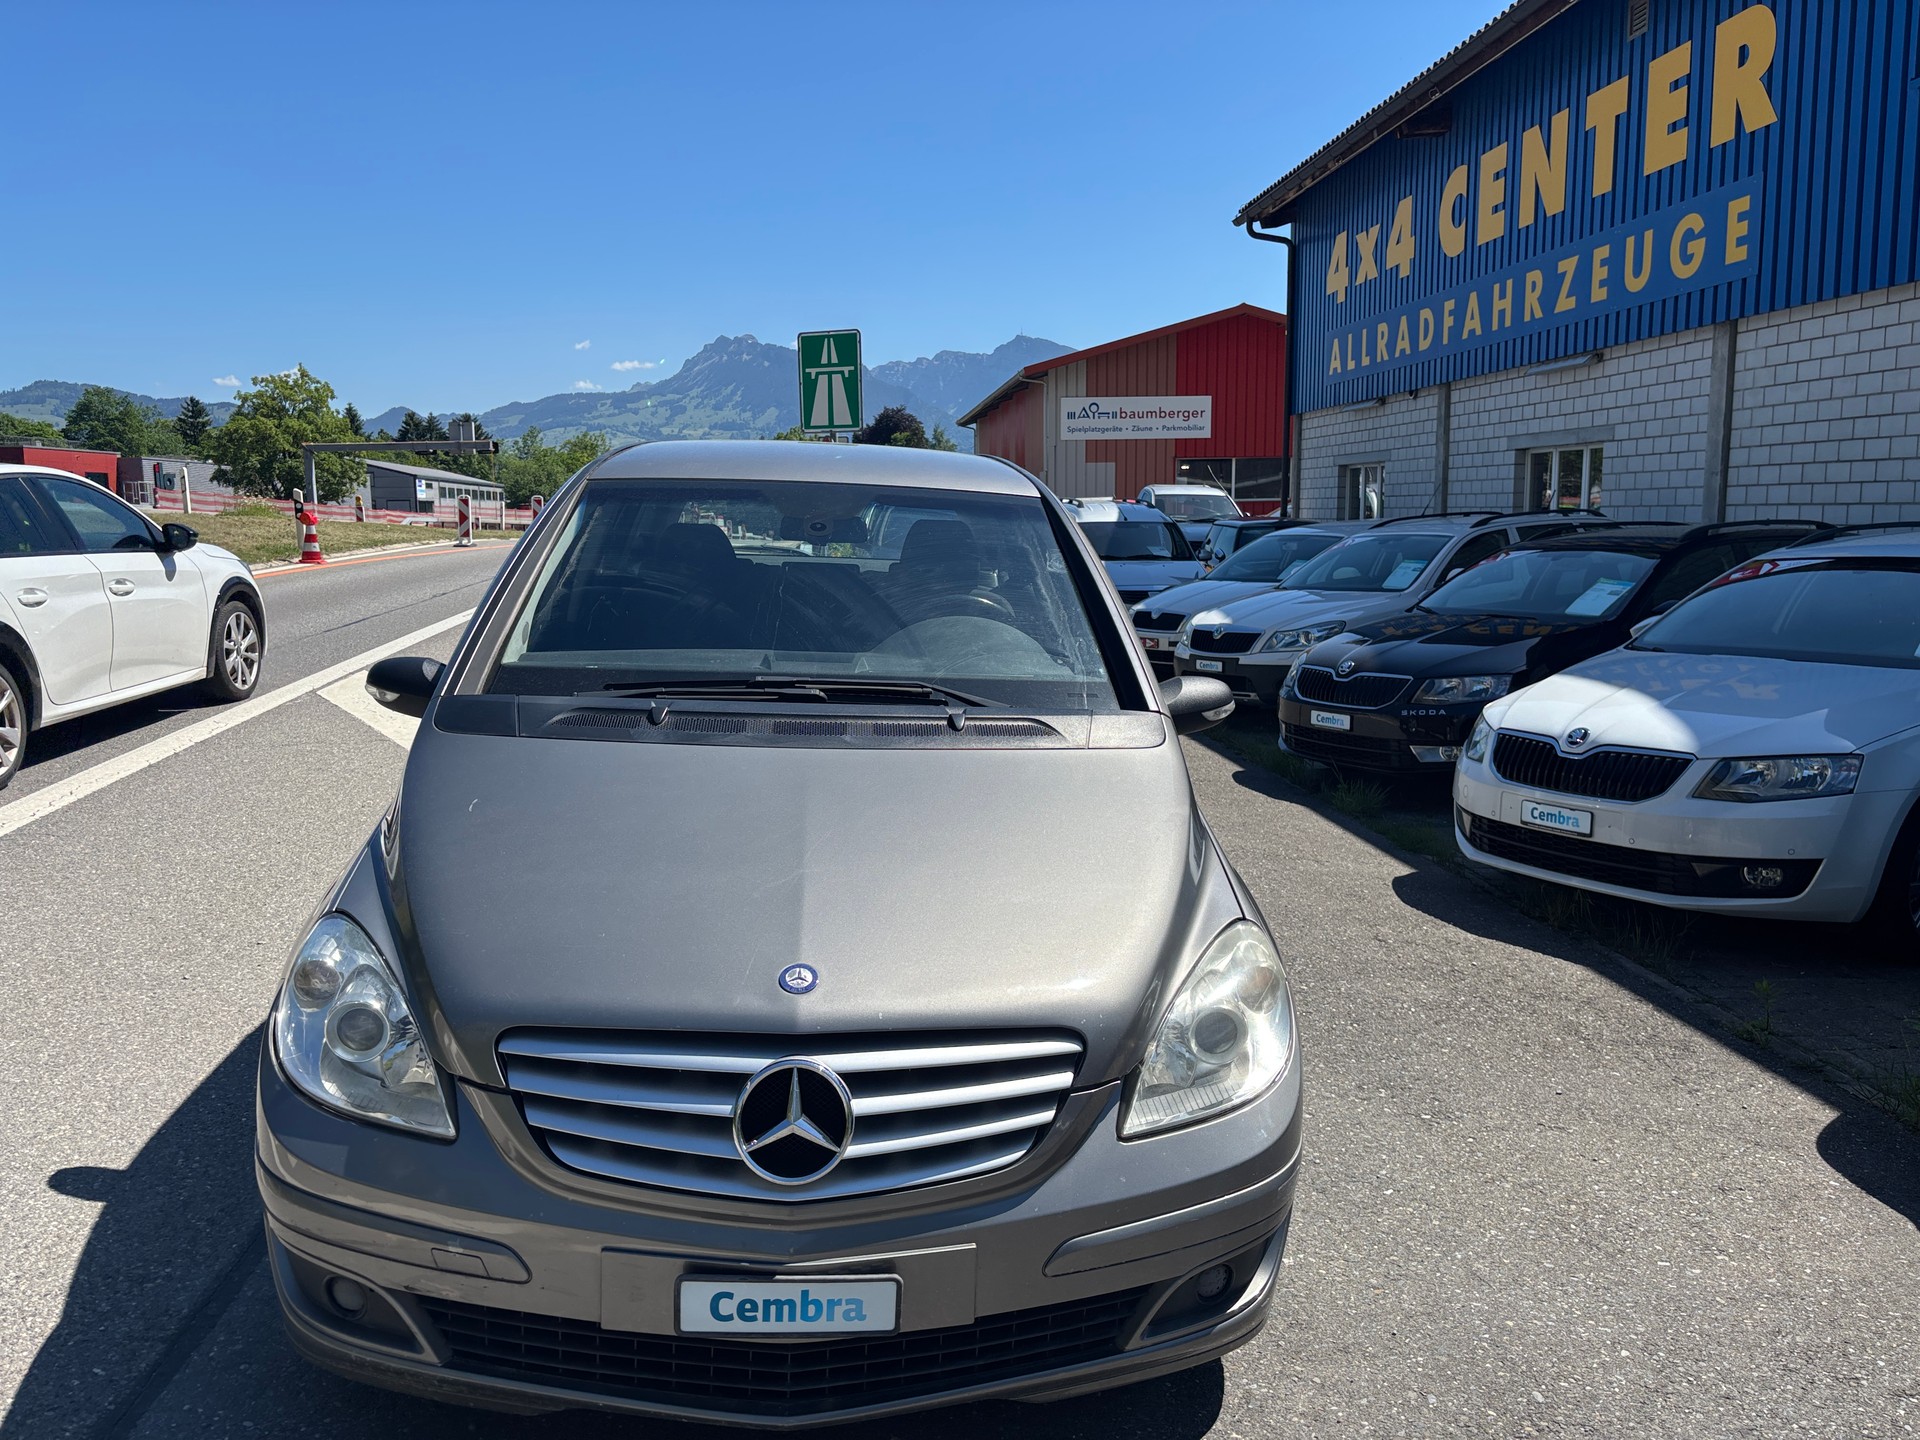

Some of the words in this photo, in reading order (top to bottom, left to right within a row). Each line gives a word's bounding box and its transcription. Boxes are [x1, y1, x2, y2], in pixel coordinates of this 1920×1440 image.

[1326, 195, 1415, 303] 4x4
[1439, 4, 1778, 258] CENTER
[1329, 195, 1751, 375] ALLRADFAHRZEUGE
[1119, 406, 1206, 422] baumberger
[1067, 425, 1123, 434] Spielplatzgeräte
[1162, 424, 1205, 432] Parkmobiliar
[1199, 661, 1219, 670] Cembra
[1316, 713, 1345, 727] Cembra
[1530, 806, 1580, 828] Cembra
[709, 1288, 867, 1323] Cembra
